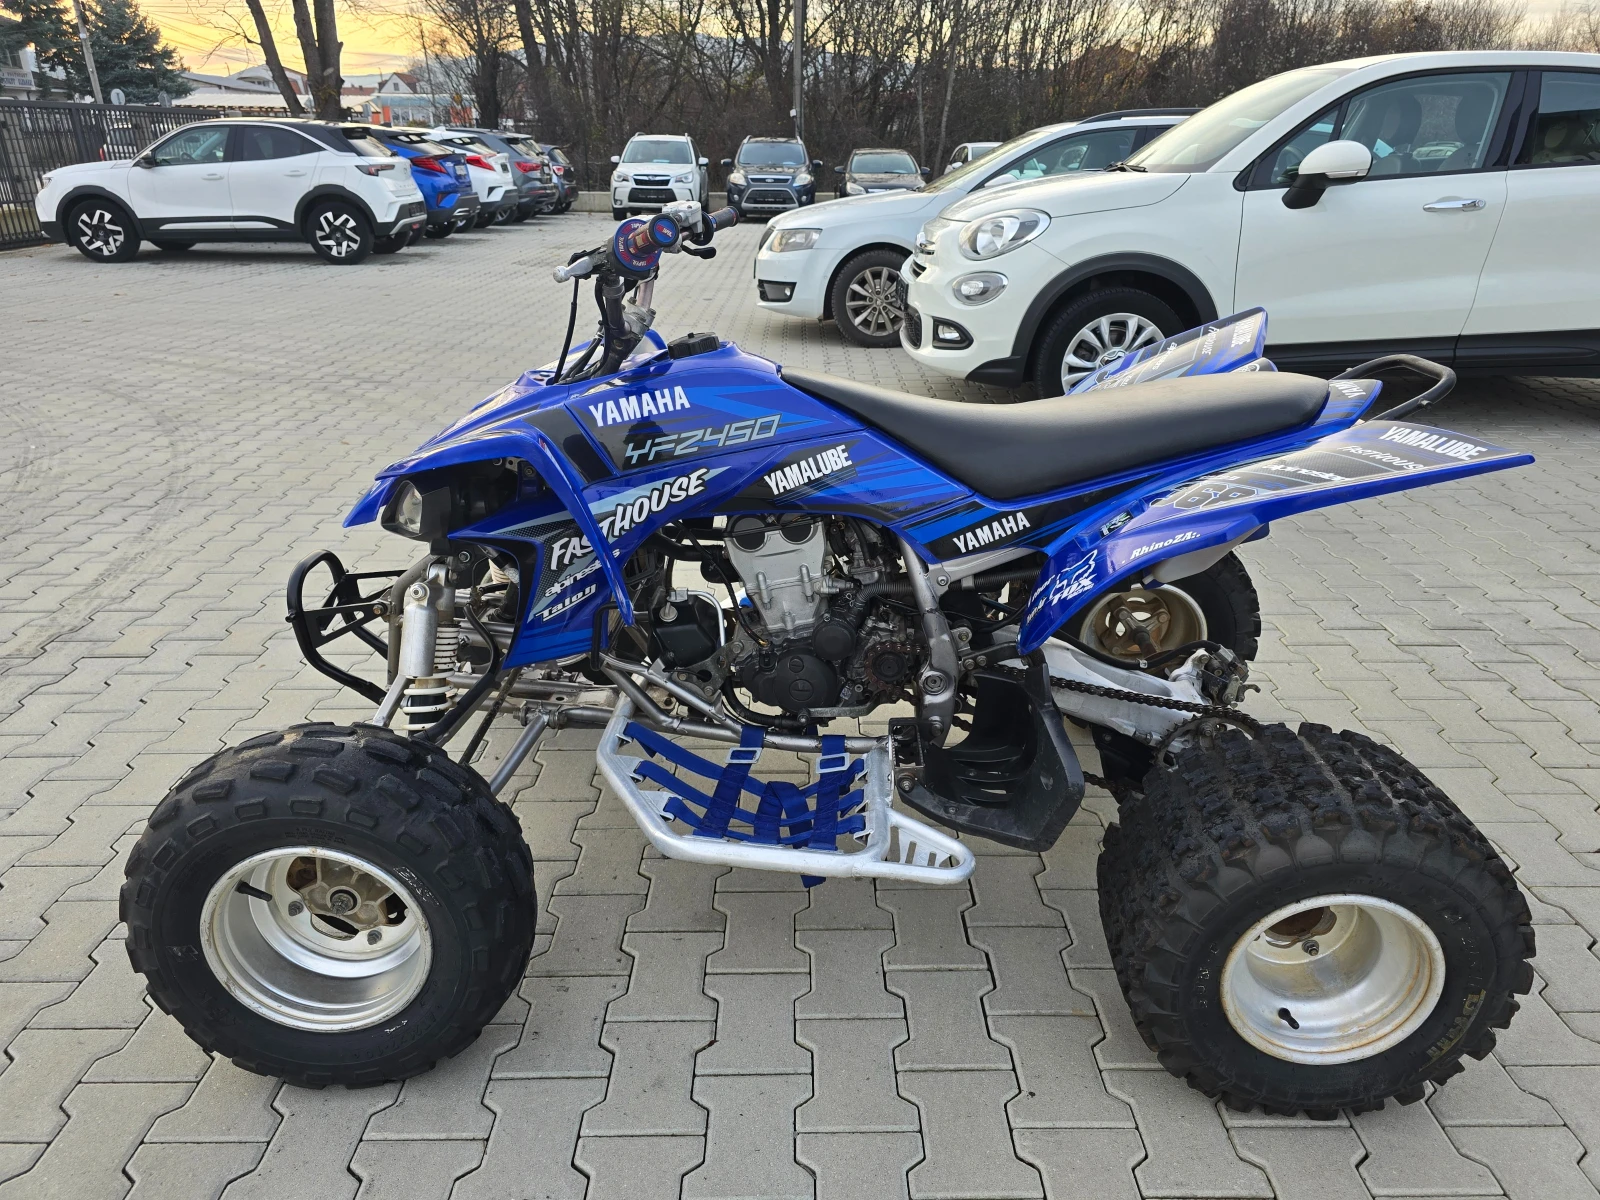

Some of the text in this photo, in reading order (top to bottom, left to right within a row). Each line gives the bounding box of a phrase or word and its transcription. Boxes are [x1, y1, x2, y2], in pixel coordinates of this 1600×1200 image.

[589, 385, 691, 428] YAMAHA
[624, 413, 782, 464] YFZ450
[1377, 426, 1488, 461] YAMALUBE
[763, 445, 853, 496] YAMALUBE
[952, 511, 1031, 554] YAMAHA
[544, 548, 621, 597] alpinests
